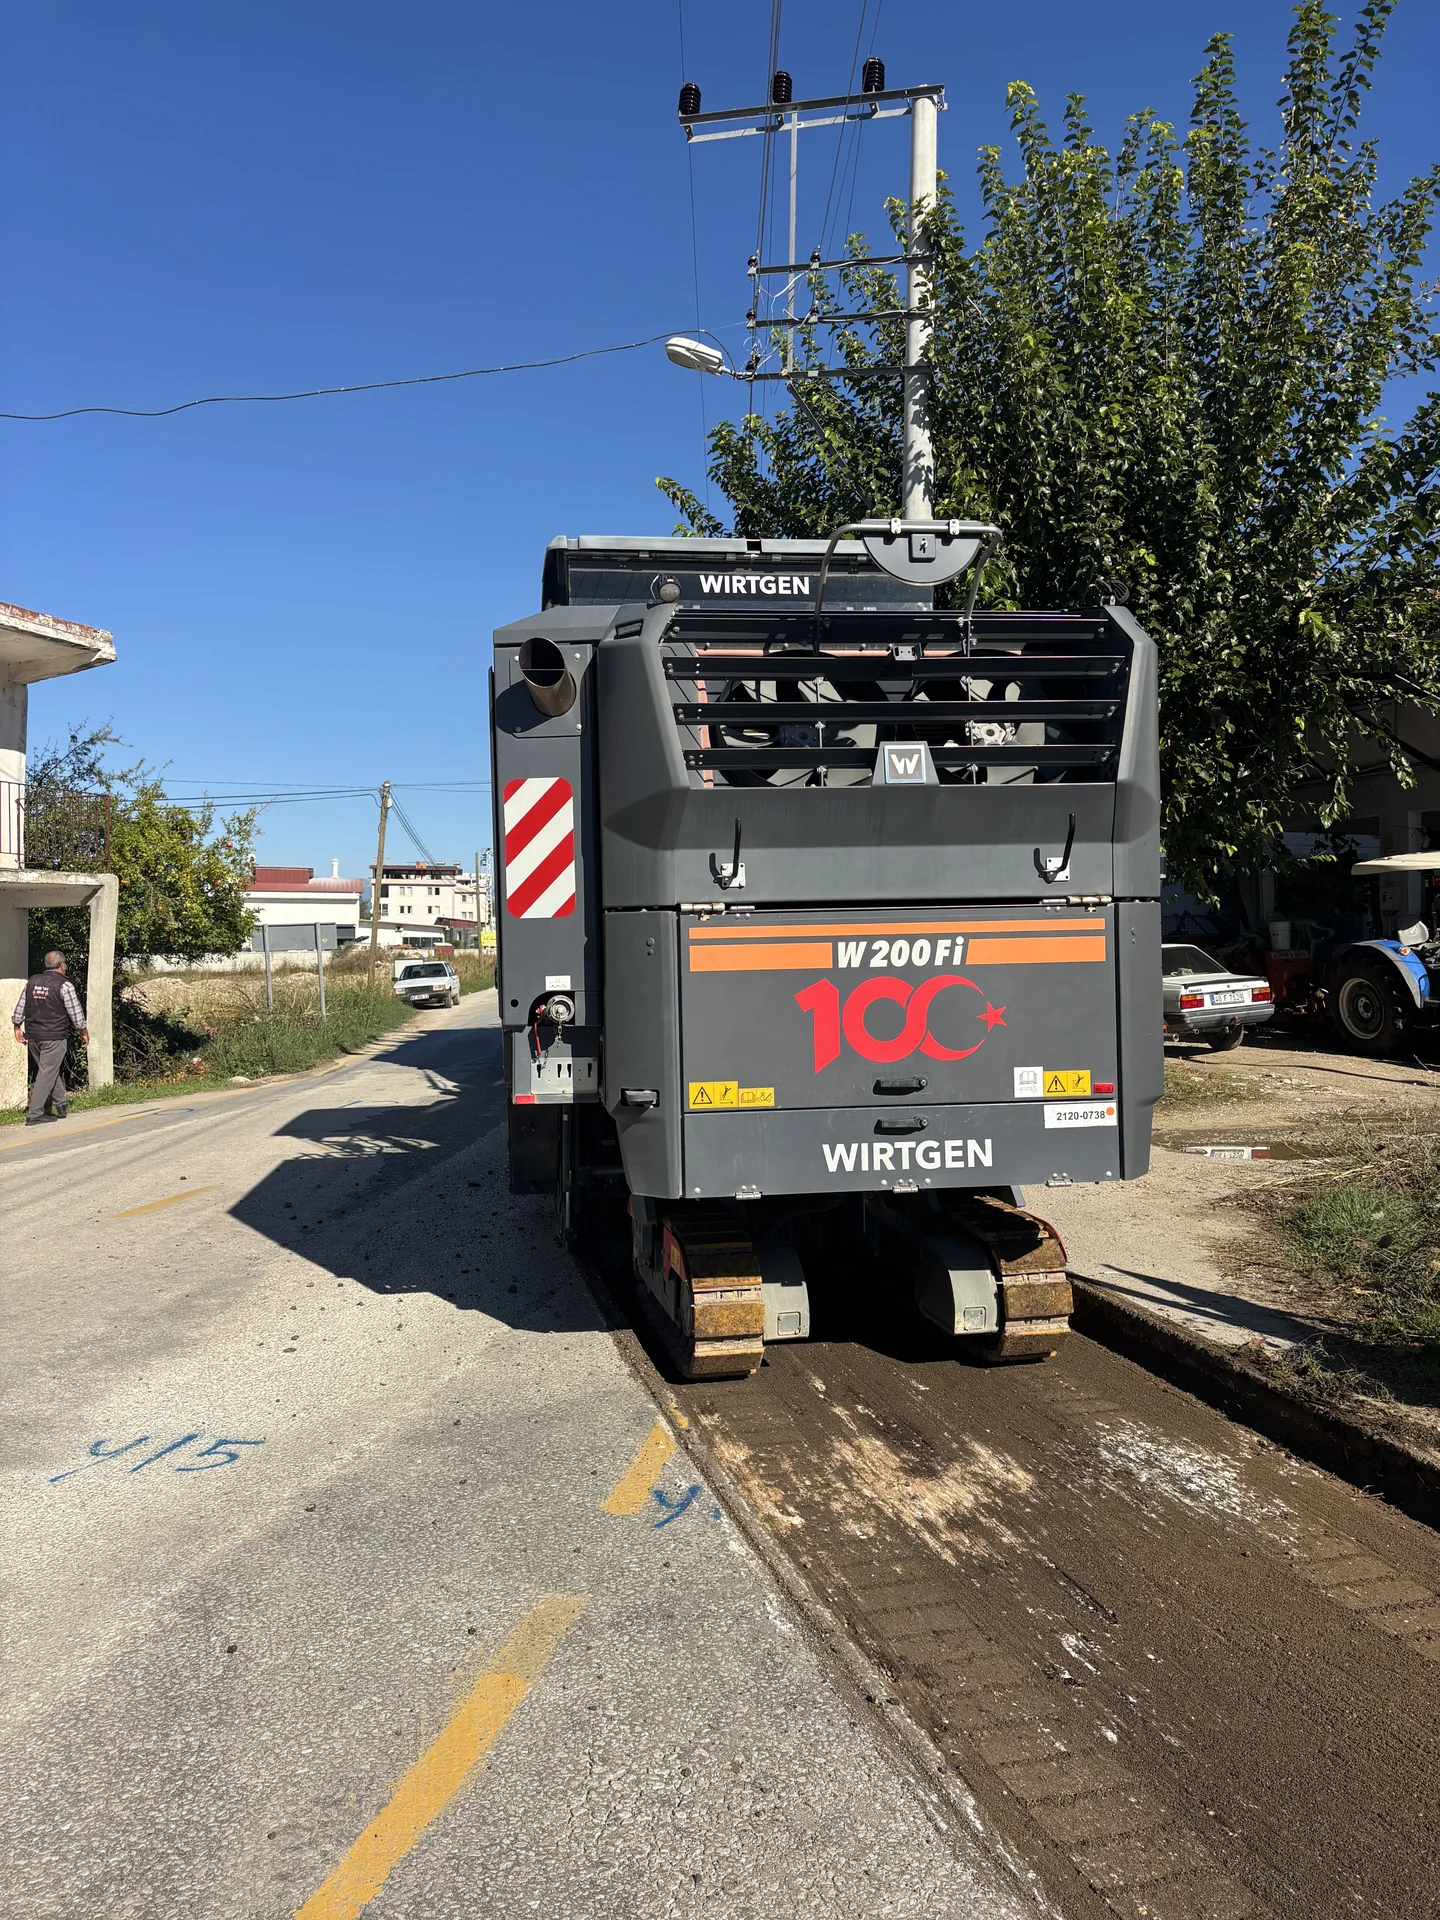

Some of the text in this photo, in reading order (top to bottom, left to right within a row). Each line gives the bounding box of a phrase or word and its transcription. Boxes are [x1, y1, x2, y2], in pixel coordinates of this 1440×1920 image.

[699, 575, 810, 595] WIRTGEN
[889, 753, 920, 775] W
[1056, 1110, 1106, 1121] 2120-0738
[822, 1139, 993, 1173] WIRTGEN
